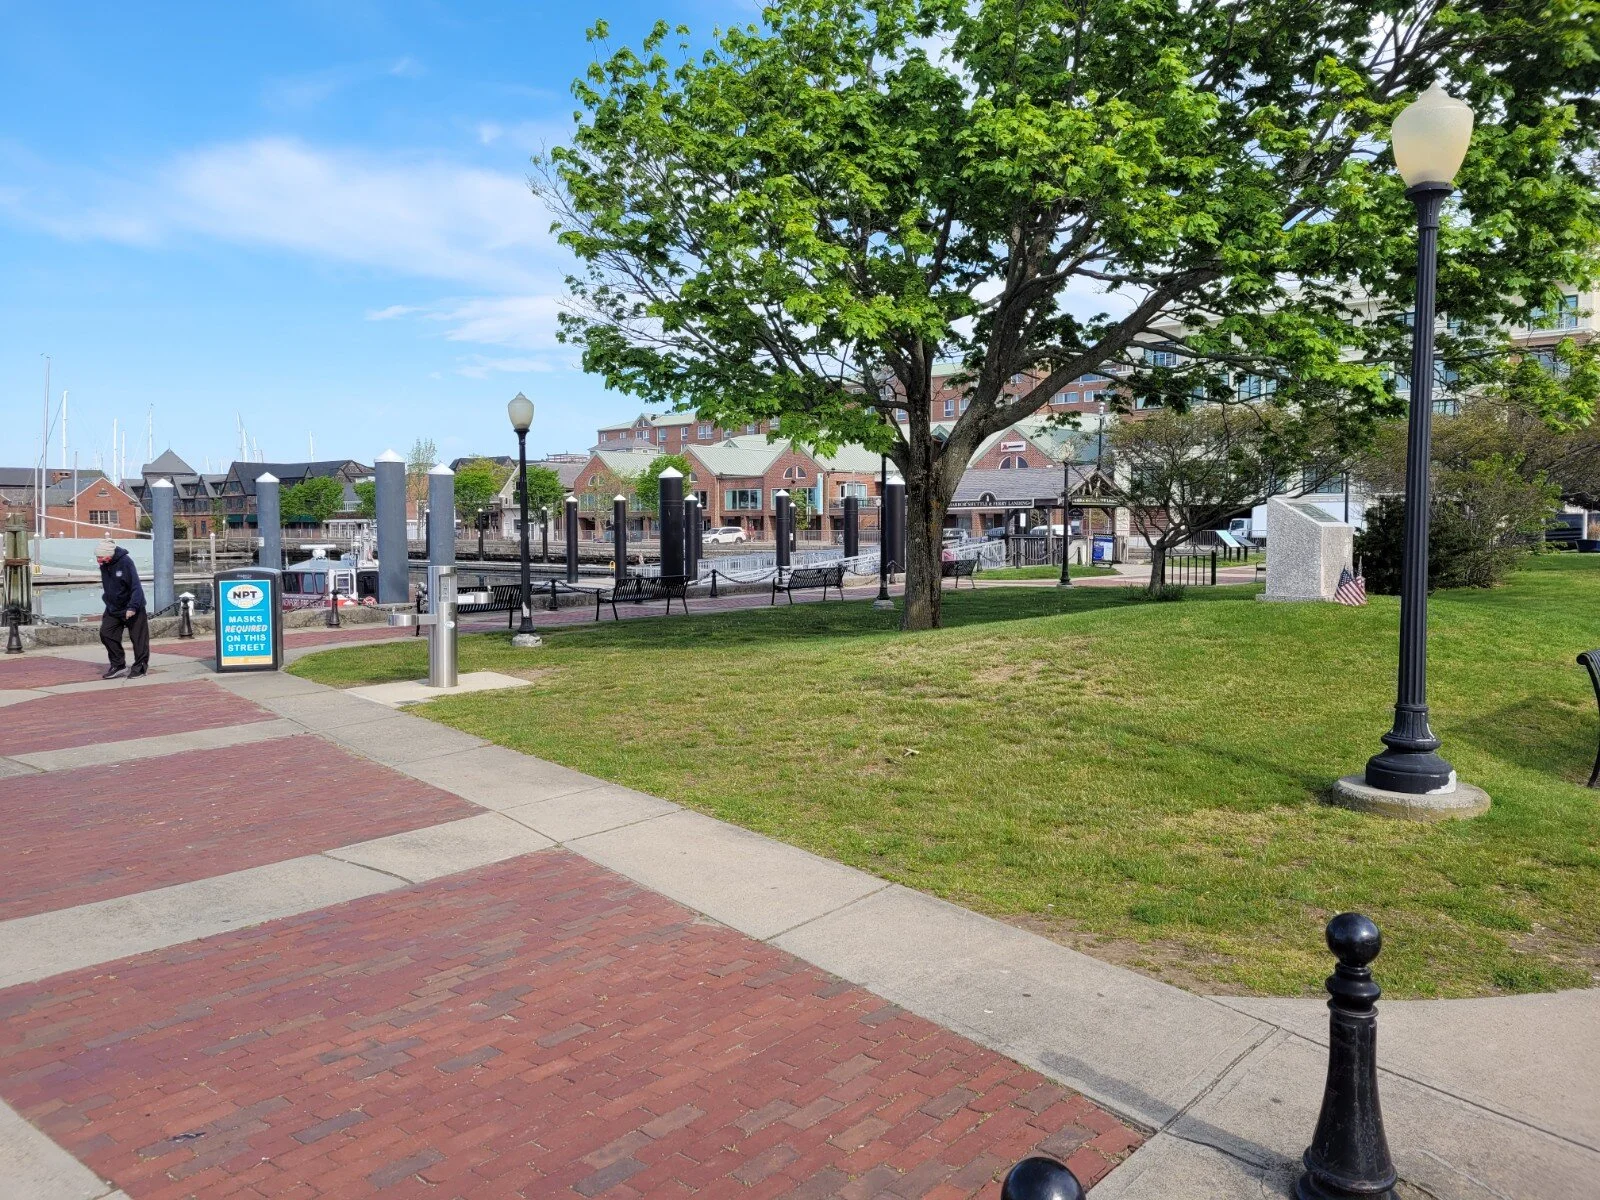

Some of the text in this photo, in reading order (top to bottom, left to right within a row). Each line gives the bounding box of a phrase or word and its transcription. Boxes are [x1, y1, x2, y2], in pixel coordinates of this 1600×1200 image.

[233, 591, 257, 599] NPT
[228, 615, 263, 623] MASKS
[225, 624, 268, 633] REQUIRED
[244, 634, 266, 642] THIS
[228, 643, 265, 652] STREET
